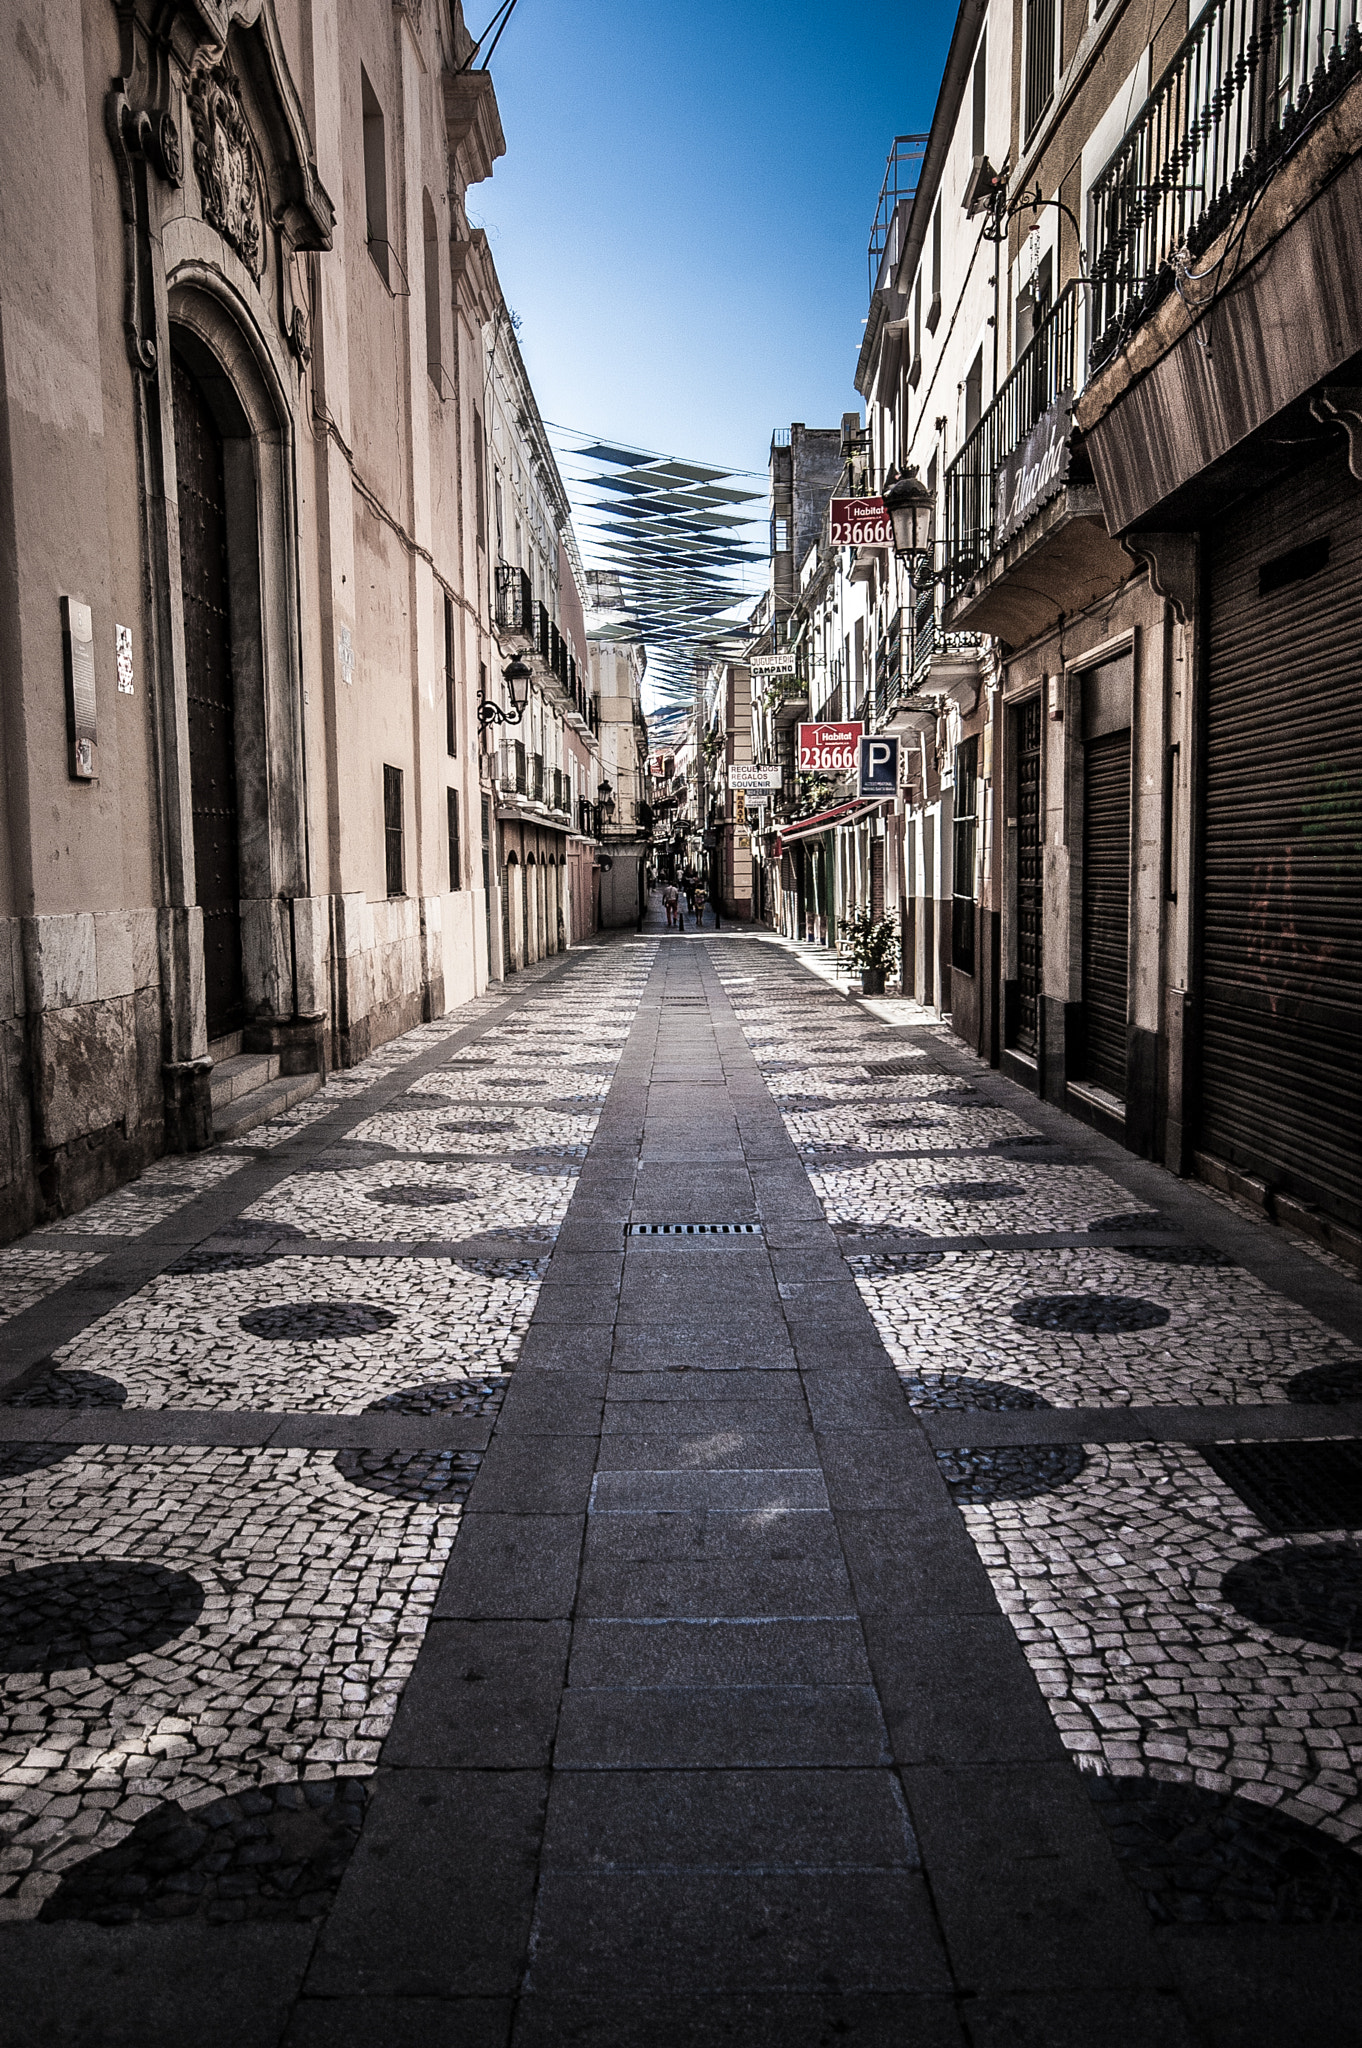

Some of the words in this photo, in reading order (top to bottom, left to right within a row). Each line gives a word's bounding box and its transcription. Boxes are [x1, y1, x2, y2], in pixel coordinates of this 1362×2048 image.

[854, 506, 884, 516] Habitat
[832, 520, 894, 544] 236666
[753, 665, 793, 675] CAMPANO
[822, 731, 852, 741] Habitat
[868, 742, 891, 778] P
[731, 780, 771, 788] SOUVENIR
